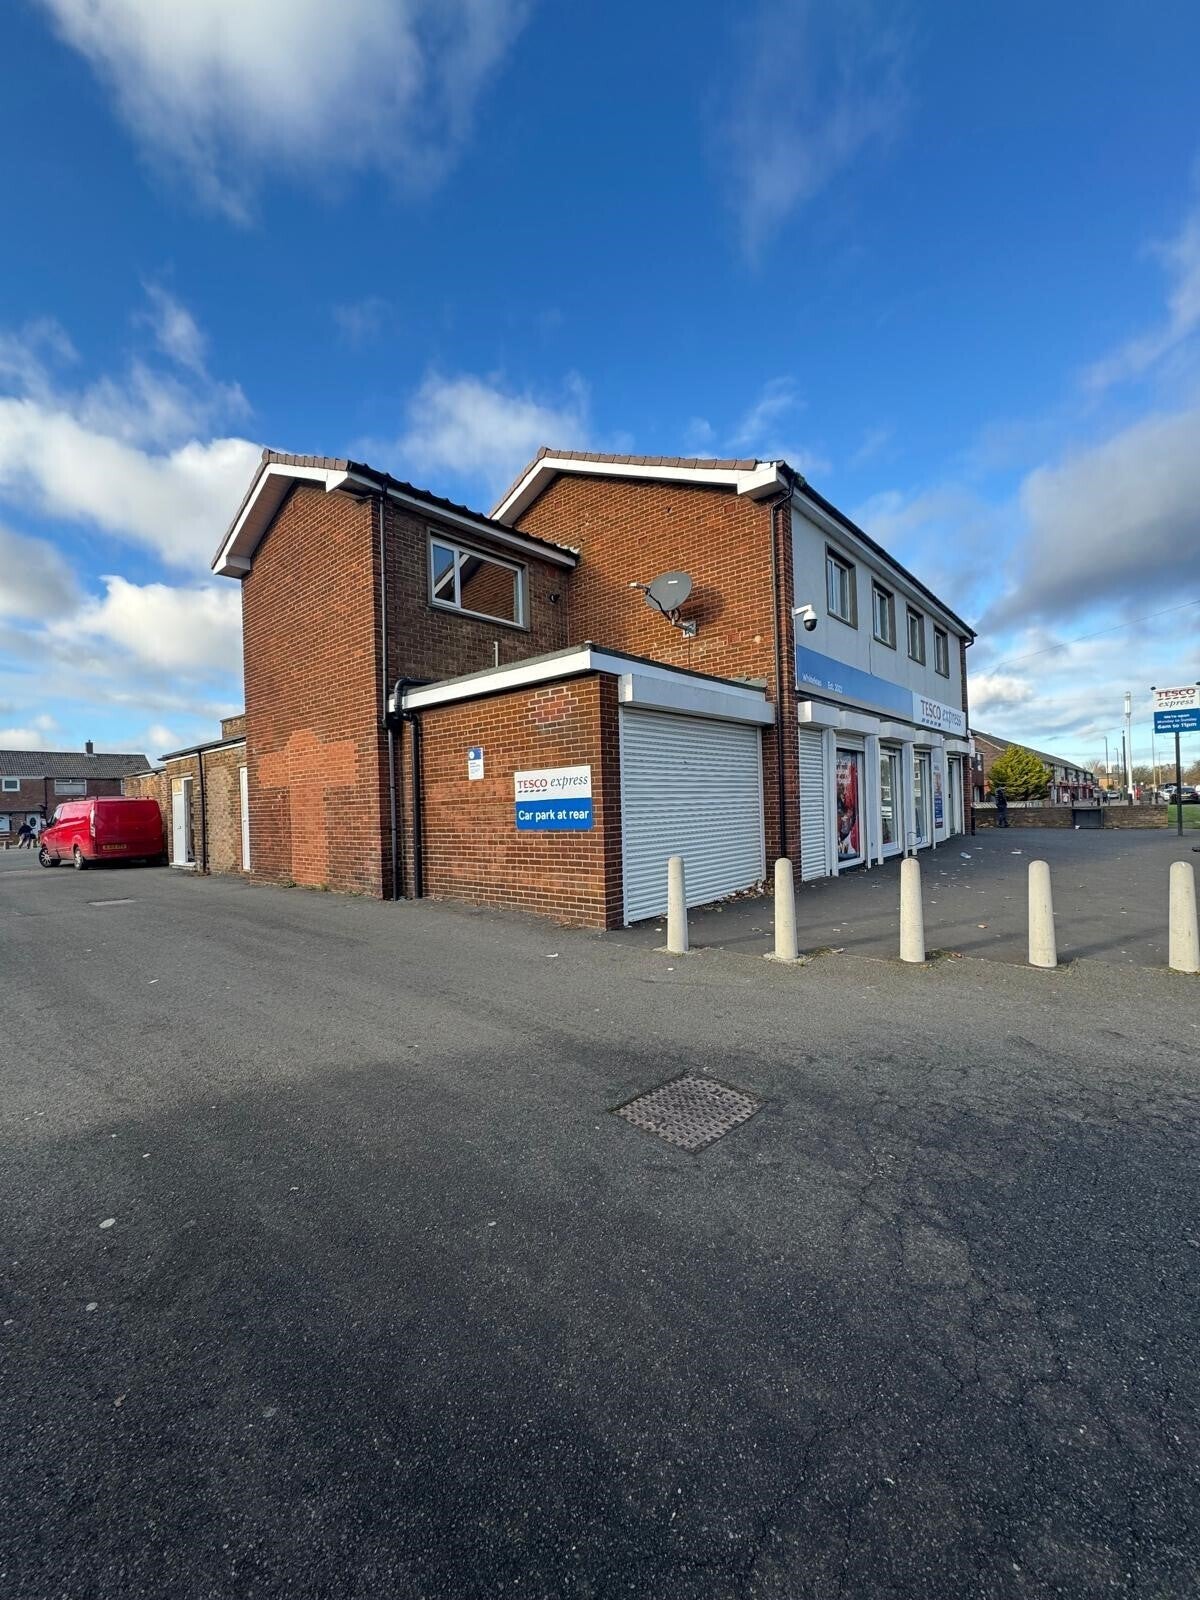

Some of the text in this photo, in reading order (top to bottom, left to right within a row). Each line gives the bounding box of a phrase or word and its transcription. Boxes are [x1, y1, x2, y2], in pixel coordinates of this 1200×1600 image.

[1156, 688, 1196, 697] TESCO
[1158, 699, 1194, 708] express
[920, 699, 962, 729] TESCO express
[517, 775, 588, 790] TESCO express
[518, 809, 590, 823] Car park at rear
